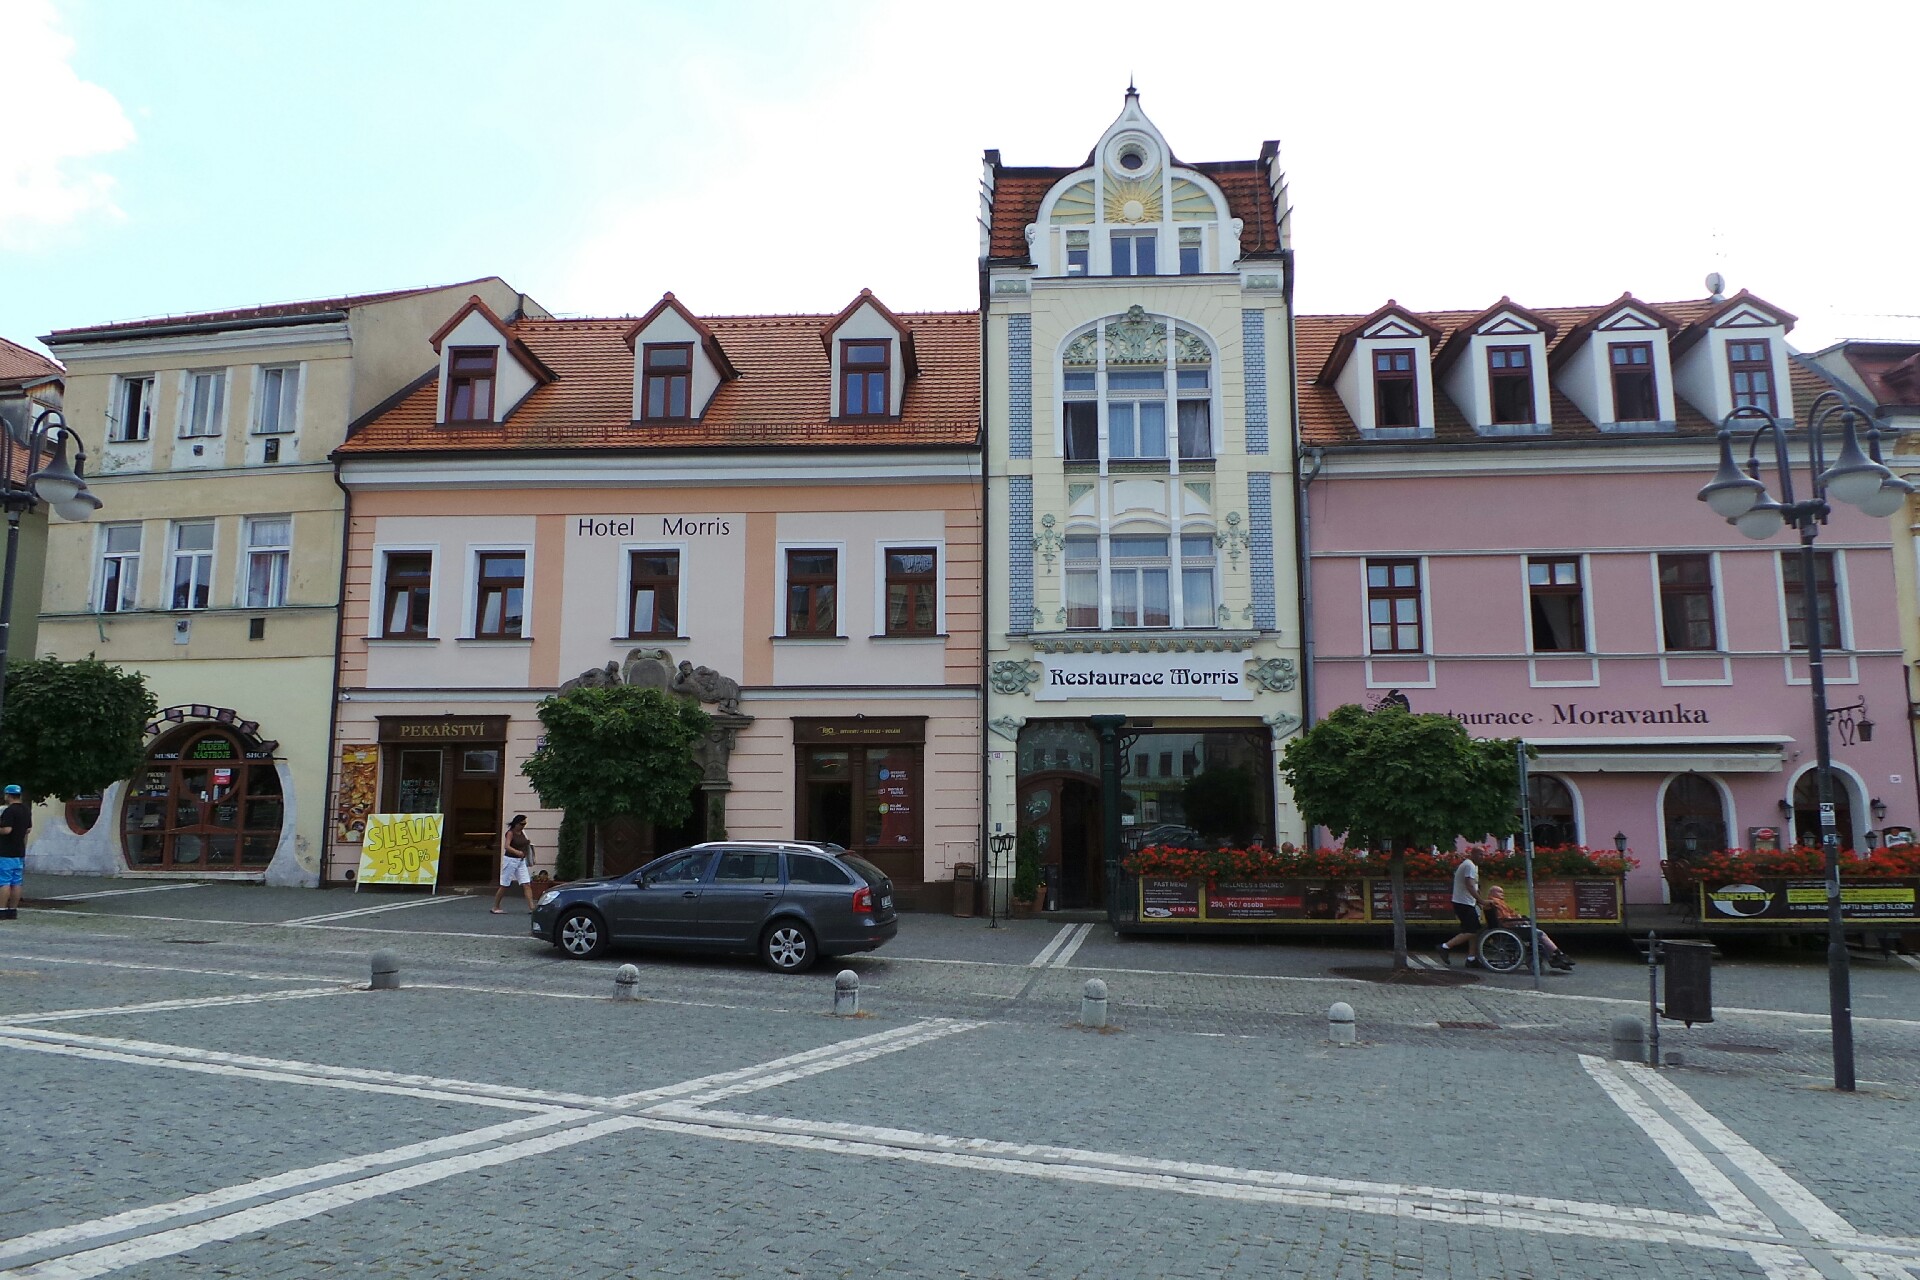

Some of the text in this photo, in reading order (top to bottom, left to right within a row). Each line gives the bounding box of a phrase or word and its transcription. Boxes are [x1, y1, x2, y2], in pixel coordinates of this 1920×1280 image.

[578, 517, 730, 536] Hotel Morris
[1050, 669, 1239, 685] Restaurace Morris
[1552, 703, 1709, 725] Moravanka
[401, 722, 486, 737] PEKAŘSTVÍ
[368, 815, 440, 852] SLEVA
[387, 846, 430, 876] 50%
[1886, 902, 1914, 910] SLOŽKY
